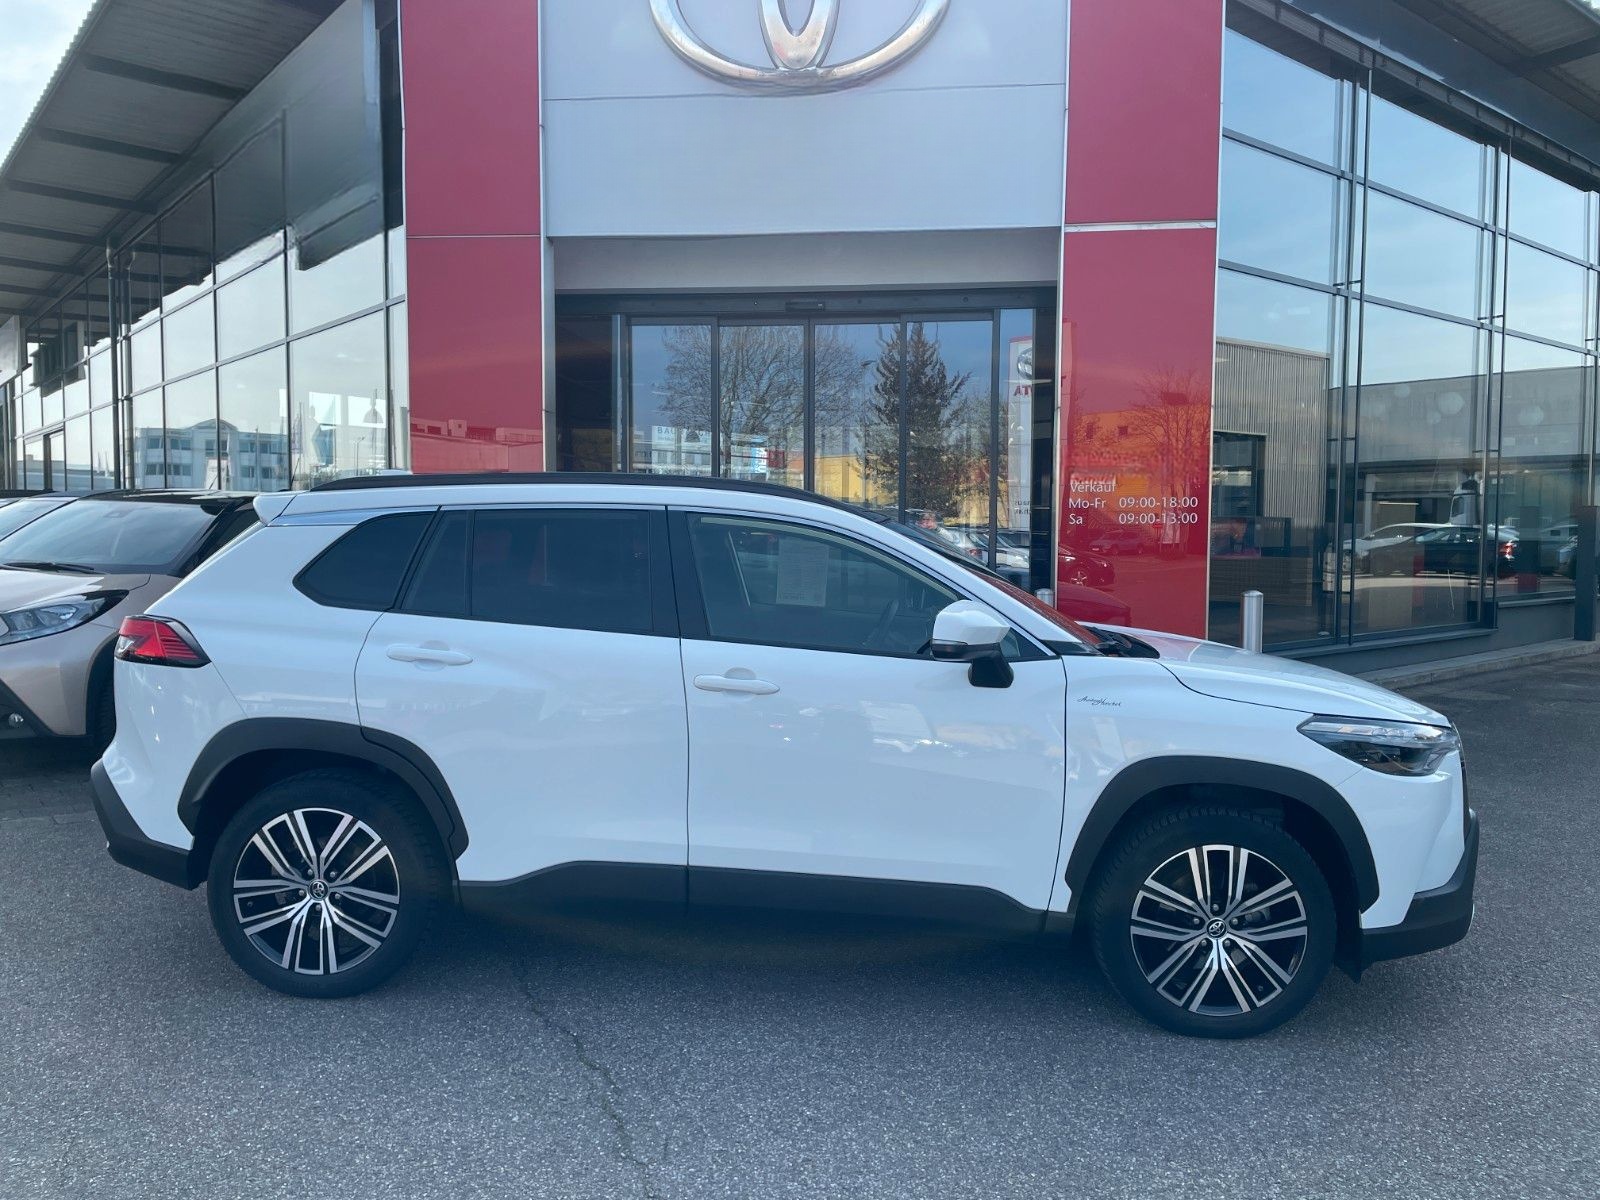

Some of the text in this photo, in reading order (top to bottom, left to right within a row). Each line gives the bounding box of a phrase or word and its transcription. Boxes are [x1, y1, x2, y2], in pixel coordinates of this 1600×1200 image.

[1070, 481, 1117, 493] Verkauf
[1068, 497, 1198, 509] Mo-Fr 09:00-18:00
[1069, 513, 1198, 525] Sa 09:00-13:00
